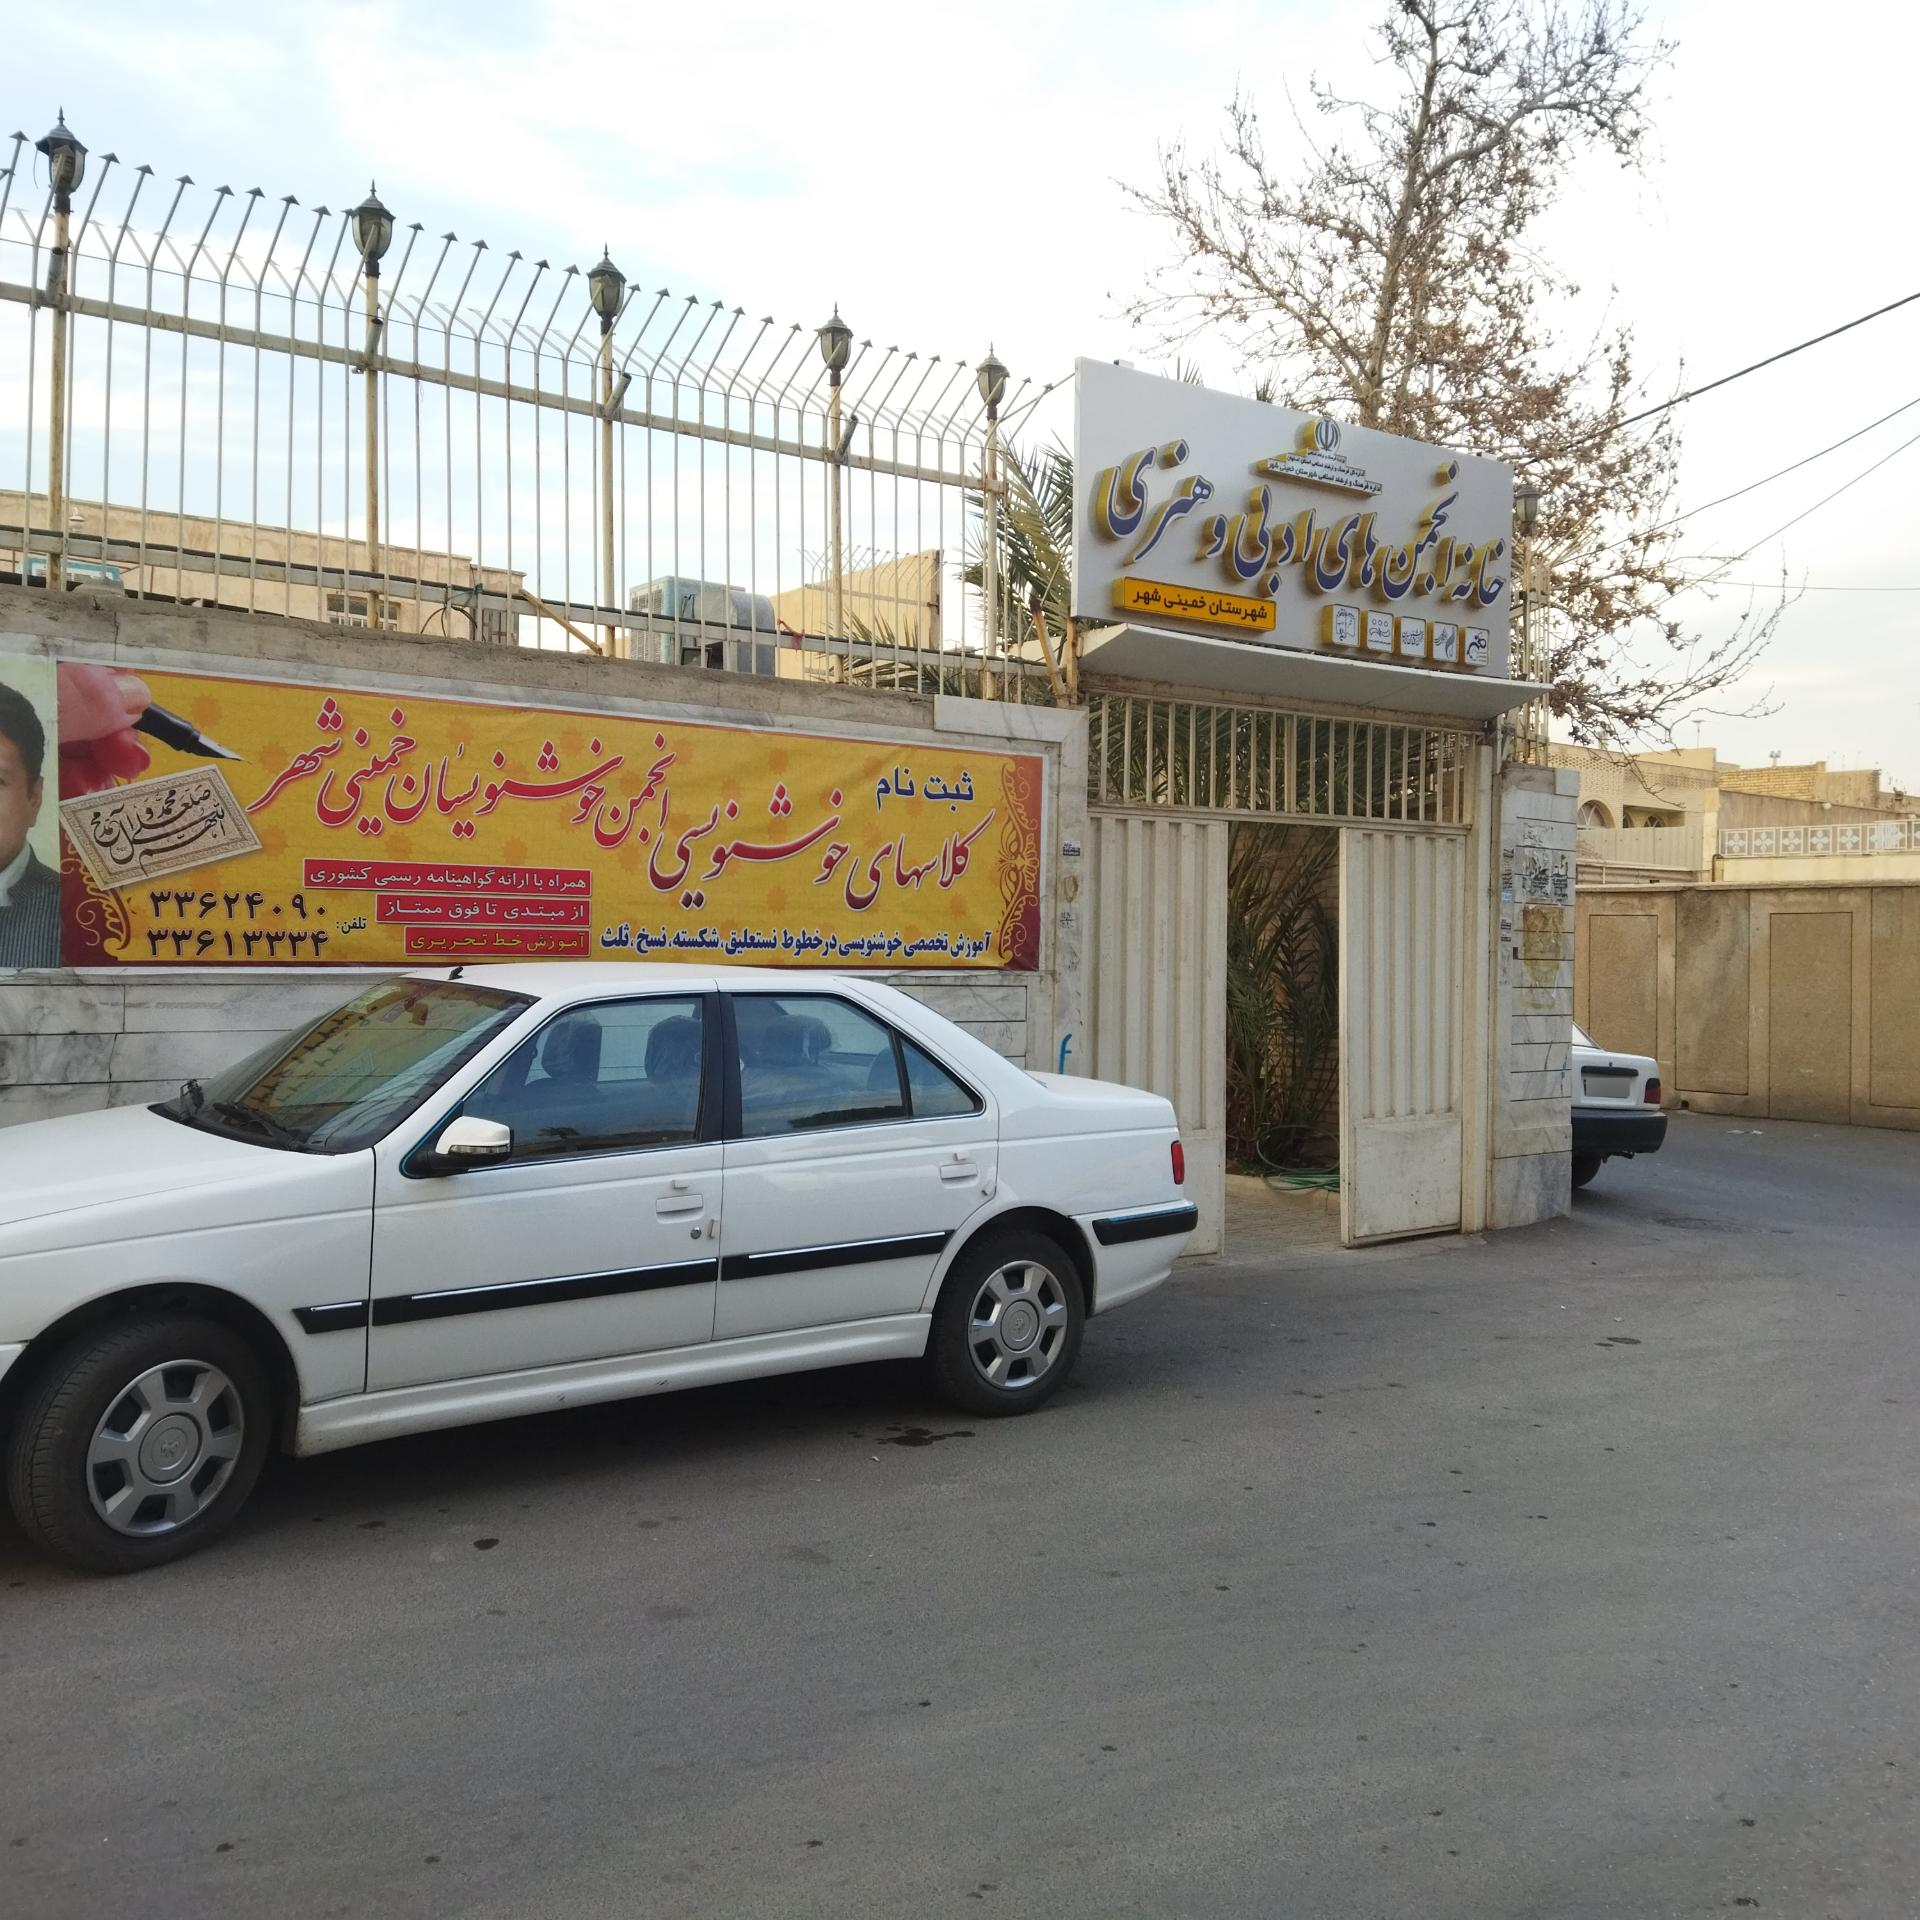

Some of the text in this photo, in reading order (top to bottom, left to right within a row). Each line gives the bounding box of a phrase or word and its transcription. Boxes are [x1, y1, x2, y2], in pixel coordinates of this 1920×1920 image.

[1268, 460, 1279, 470] شهر
[1279, 464, 1295, 473] خمینی
[1295, 467, 1318, 478] شهرستان
[1335, 475, 1348, 486] ارشاد
[1352, 479, 1369, 490] فرهنگ
[1106, 438, 1505, 606] خانه انجمن های ادبی و هنری
[1132, 588, 1268, 622] شهرستان خمینی شهر
[246, 695, 344, 813] شهر
[316, 707, 417, 836] خمینی
[593, 731, 677, 848] انجمن
[875, 764, 975, 813] ثبت نام
[648, 781, 851, 910] خوشنویسی
[844, 808, 996, 912] کلاسهای
[309, 866, 587, 891] همراه با ارائه گواهینامه رسمی کشوری
[149, 889, 328, 920] ۳۳۶۲۴۰۹۰
[385, 900, 585, 921] از مبتدی تا فوق ممتاز
[335, 916, 368, 935] تلفن:
[600, 923, 630, 949] ثلث
[146, 928, 330, 958] ۳۳۶۱۳۳۳۴
[410, 932, 586, 952] آموزش خط تحریری
[781, 927, 823, 957] خطوط
[820, 933, 838, 957] در
[838, 930, 902, 958] خوشنویسی
[902, 931, 949, 958] تخصصی
[950, 931, 993, 959] آموزش
